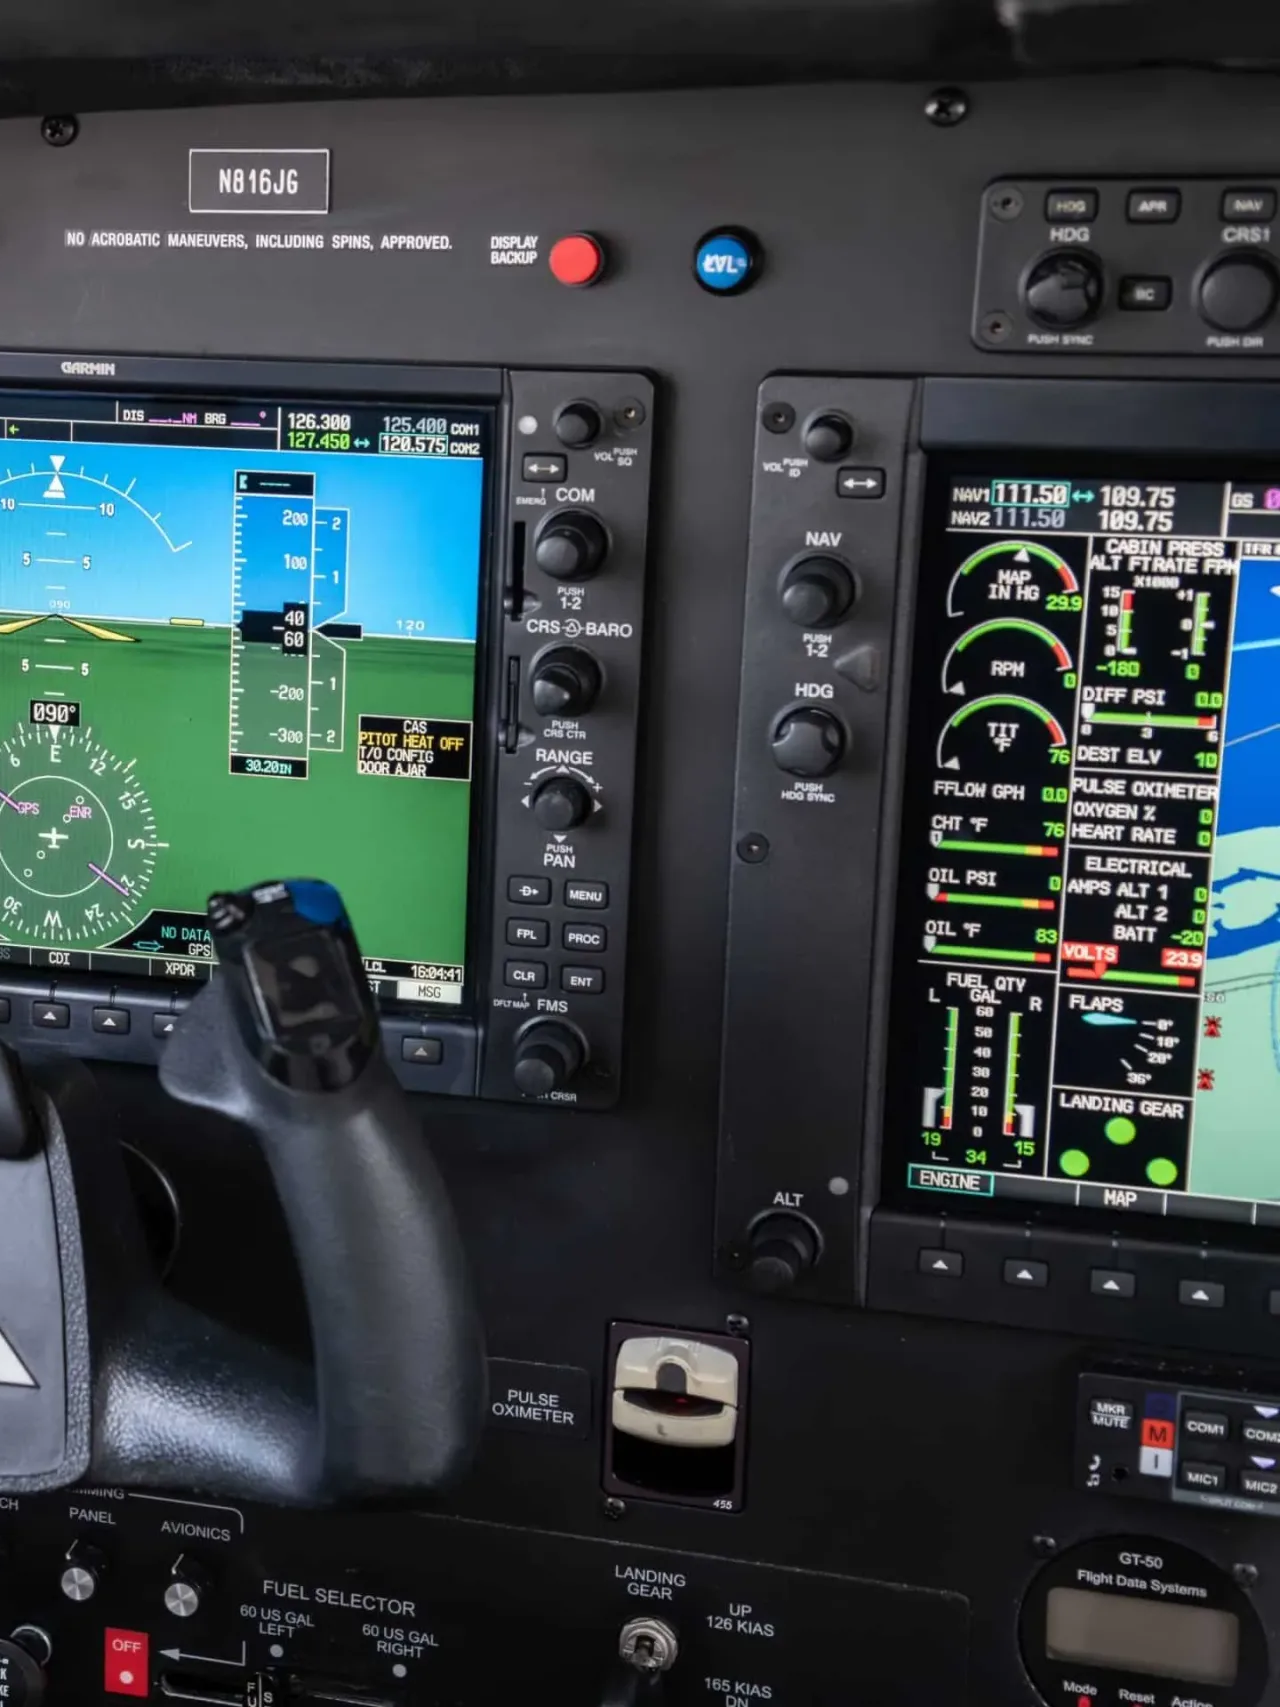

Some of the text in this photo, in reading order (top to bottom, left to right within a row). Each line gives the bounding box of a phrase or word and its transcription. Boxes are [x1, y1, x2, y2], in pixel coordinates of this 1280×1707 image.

[220, 169, 298, 194] N816JG
[67, 233, 452, 251] NO ACROBATIC MANEUVERS, INCLUDING SPINS, APPROVED.
[491, 236, 538, 249] DISPLAY
[1050, 228, 1089, 242] HDG
[1222, 228, 1270, 242] CRS1
[491, 252, 537, 264] BACKUP
[61, 362, 115, 376] GARMIN
[123, 409, 144, 422] DIS
[205, 412, 226, 425] BRG
[288, 412, 479, 437] 126.300 125.400 COM1
[288, 432, 479, 454] 127.450 120.575 COM2
[556, 489, 595, 502] COM
[996, 484, 1175, 508] 111.50 109.75
[806, 532, 841, 547] NAV
[1106, 540, 1224, 556] CABIN PRESS
[585, 624, 632, 637] BARO
[991, 662, 1024, 677] RPM
[795, 684, 833, 698] HDG
[1083, 687, 1165, 706] DIFF PSI
[403, 720, 426, 733] CAS
[361, 733, 463, 750] PITOT HEAT OFF
[359, 747, 433, 762] T/O CONFIG
[536, 749, 593, 765] RANGE
[1078, 747, 1162, 765] DEST ELV
[359, 761, 426, 777] DOOR AJAR
[1072, 779, 1218, 799] PULSE OXIMETER
[18, 802, 39, 814] GPS
[70, 806, 92, 818] ENR
[1073, 802, 1138, 819] OXYGEN
[1072, 824, 1176, 844] HEART RATE
[543, 855, 575, 868] PAN
[1086, 857, 1192, 878] ELECTRICAL
[570, 890, 602, 902] MENU
[569, 933, 599, 945] PROC
[49, 951, 70, 966] CDI
[411, 964, 462, 982] 16:04:41
[514, 971, 535, 982] CLR
[570, 977, 592, 987] ENT
[947, 973, 1026, 992] FUEL QTY
[418, 985, 441, 998] MSG
[537, 999, 568, 1012] FMS
[1070, 995, 1124, 1012] FLAPS
[1060, 1094, 1183, 1118] LANDING GEAR
[920, 1171, 980, 1189] ENGINE
[773, 1191, 804, 1206] ALT
[1104, 1190, 1136, 1205] MAP
[508, 1389, 559, 1408] PULSE
[492, 1403, 574, 1425] OXIMETER
[1097, 1402, 1125, 1414] MKR
[1092, 1417, 1128, 1429] MUTE
[1187, 1421, 1224, 1435] COM1
[1188, 1471, 1218, 1485] MIC1
[69, 1507, 115, 1525] PANEL
[161, 1521, 231, 1541] AVIONICS
[1119, 1552, 1163, 1570] GT-50
[616, 1565, 686, 1587] LANDING
[1077, 1569, 1207, 1598] Flight Data Systems
[263, 1580, 415, 1617] FUEL SELECTOR
[627, 1583, 672, 1600] GEAR
[729, 1603, 752, 1617] UP
[260, 1623, 295, 1638] LEFT
[707, 1616, 774, 1637] 126 KIAS
[112, 1639, 140, 1652] OFF
[377, 1640, 423, 1658] RIGHT
[705, 1677, 772, 1698] 165 KIAS
[1063, 1681, 1097, 1696] Mode
[1119, 1689, 1155, 1704] Reset
